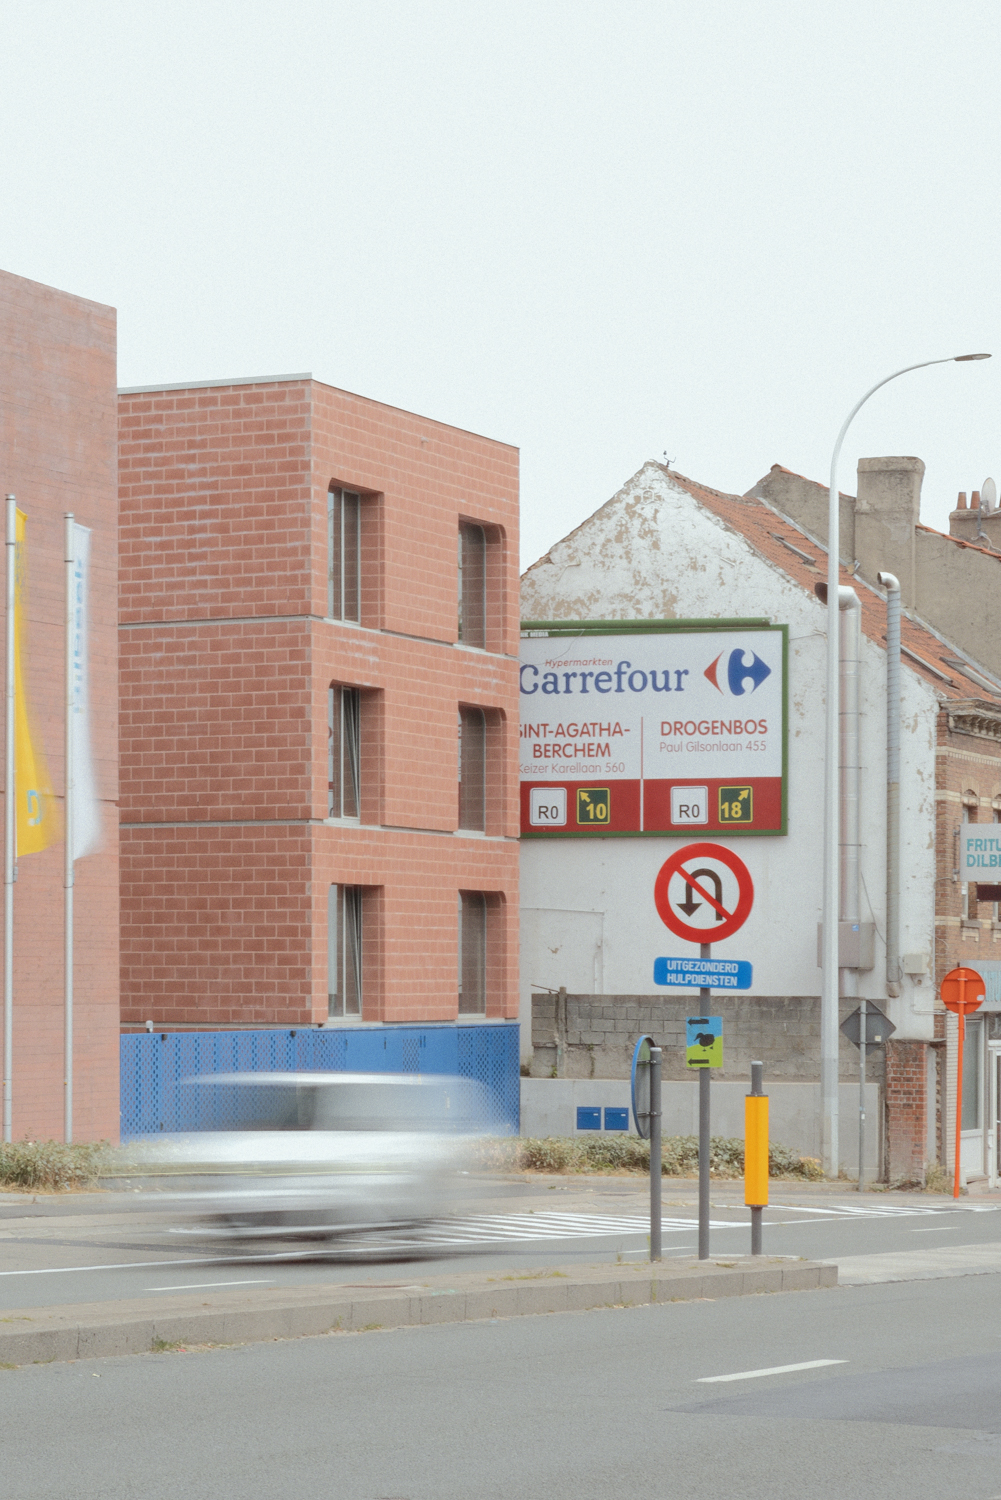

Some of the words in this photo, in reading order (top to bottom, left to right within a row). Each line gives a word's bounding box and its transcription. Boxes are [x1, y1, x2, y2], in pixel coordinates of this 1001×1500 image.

[545, 658, 613, 669] Hypermarkten
[520, 660, 689, 695] Carrefour
[660, 719, 768, 736] DROGENBOS
[533, 742, 611, 758] BERCHEM
[659, 741, 683, 753] Paul
[685, 740, 743, 753] Gilsonlaan
[745, 740, 767, 752] 455
[551, 762, 602, 774] Karellaan
[604, 762, 626, 773] 560
[586, 803, 607, 820] 10
[721, 801, 742, 818] 18
[666, 960, 739, 974] UITGEZONDERD
[666, 973, 738, 987] HULPDIENSTEN
